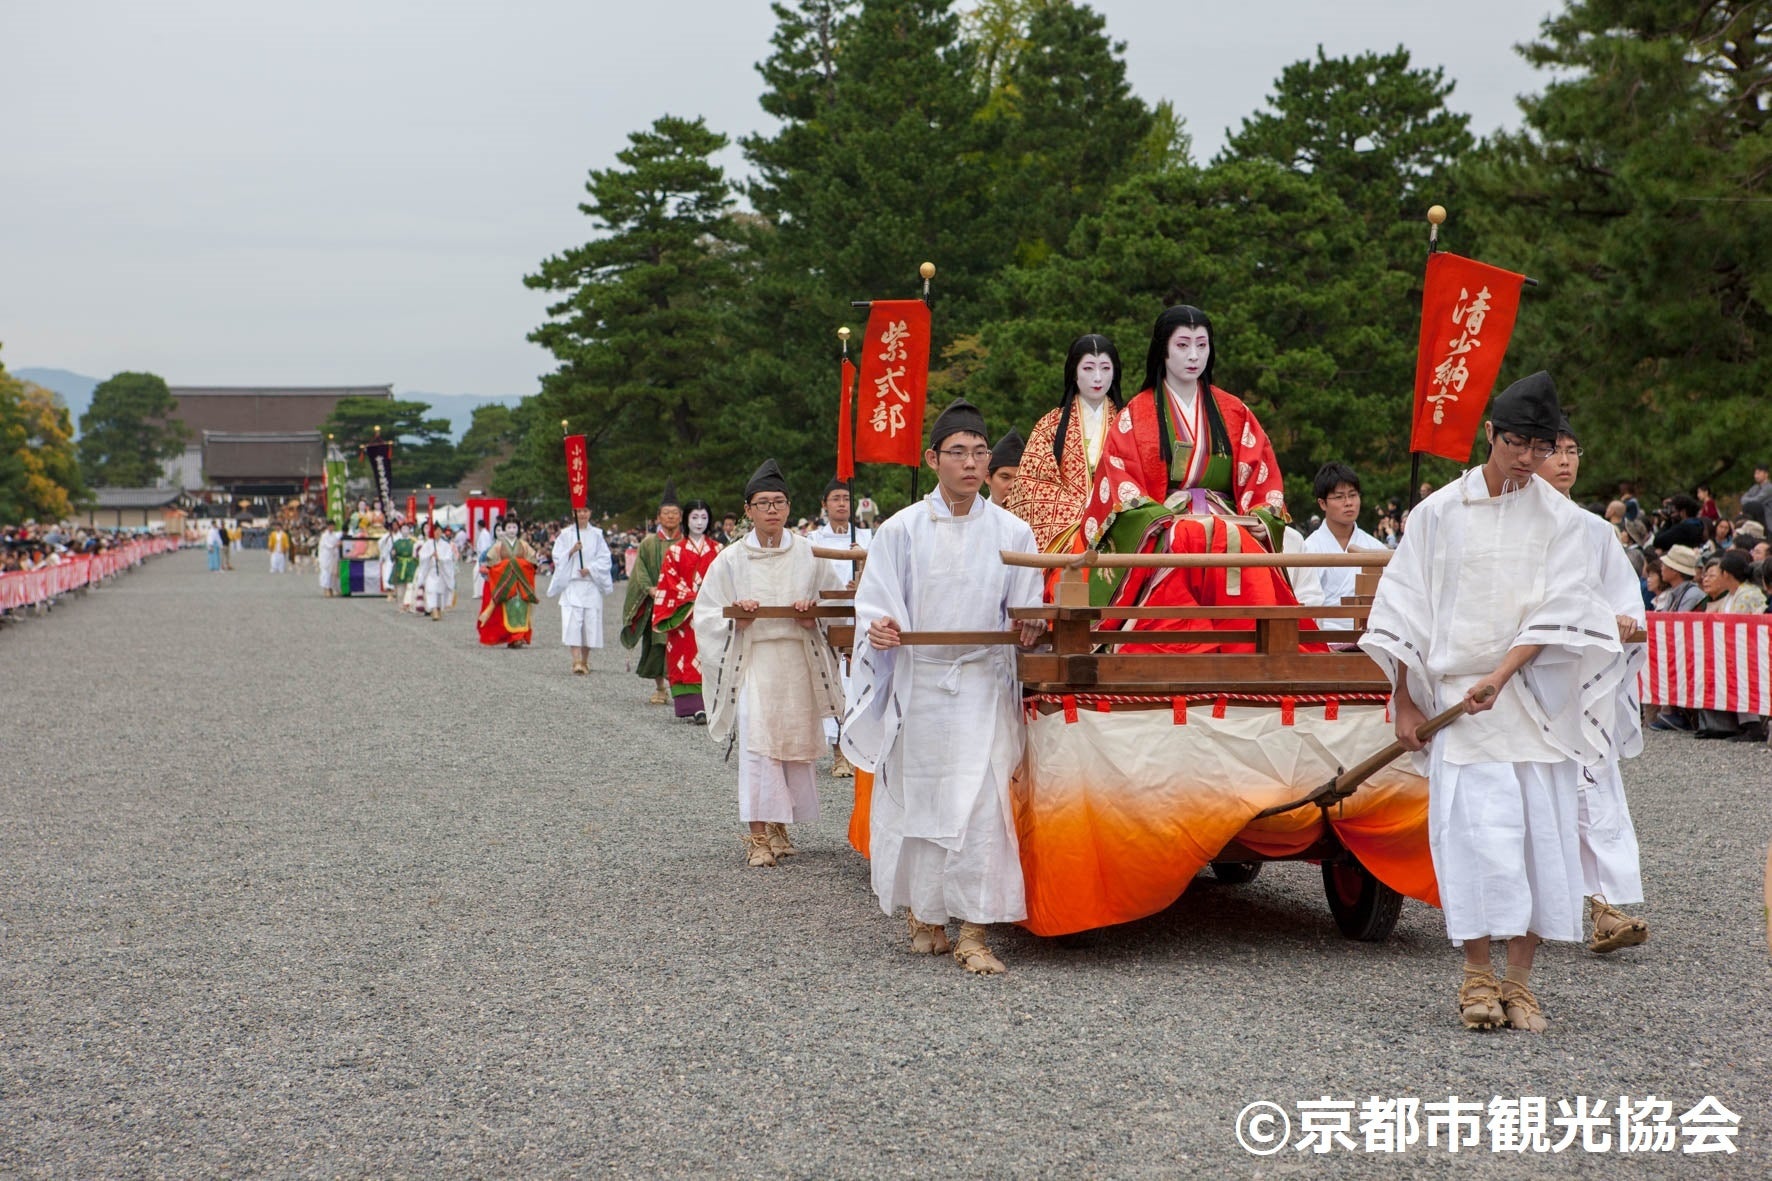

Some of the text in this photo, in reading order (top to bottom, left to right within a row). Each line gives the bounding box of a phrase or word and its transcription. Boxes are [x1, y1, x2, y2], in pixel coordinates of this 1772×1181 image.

[870, 321, 910, 437] 紫式部
[1427, 286, 1492, 425] 清少納言
[571, 444, 584, 497] 小野小町
